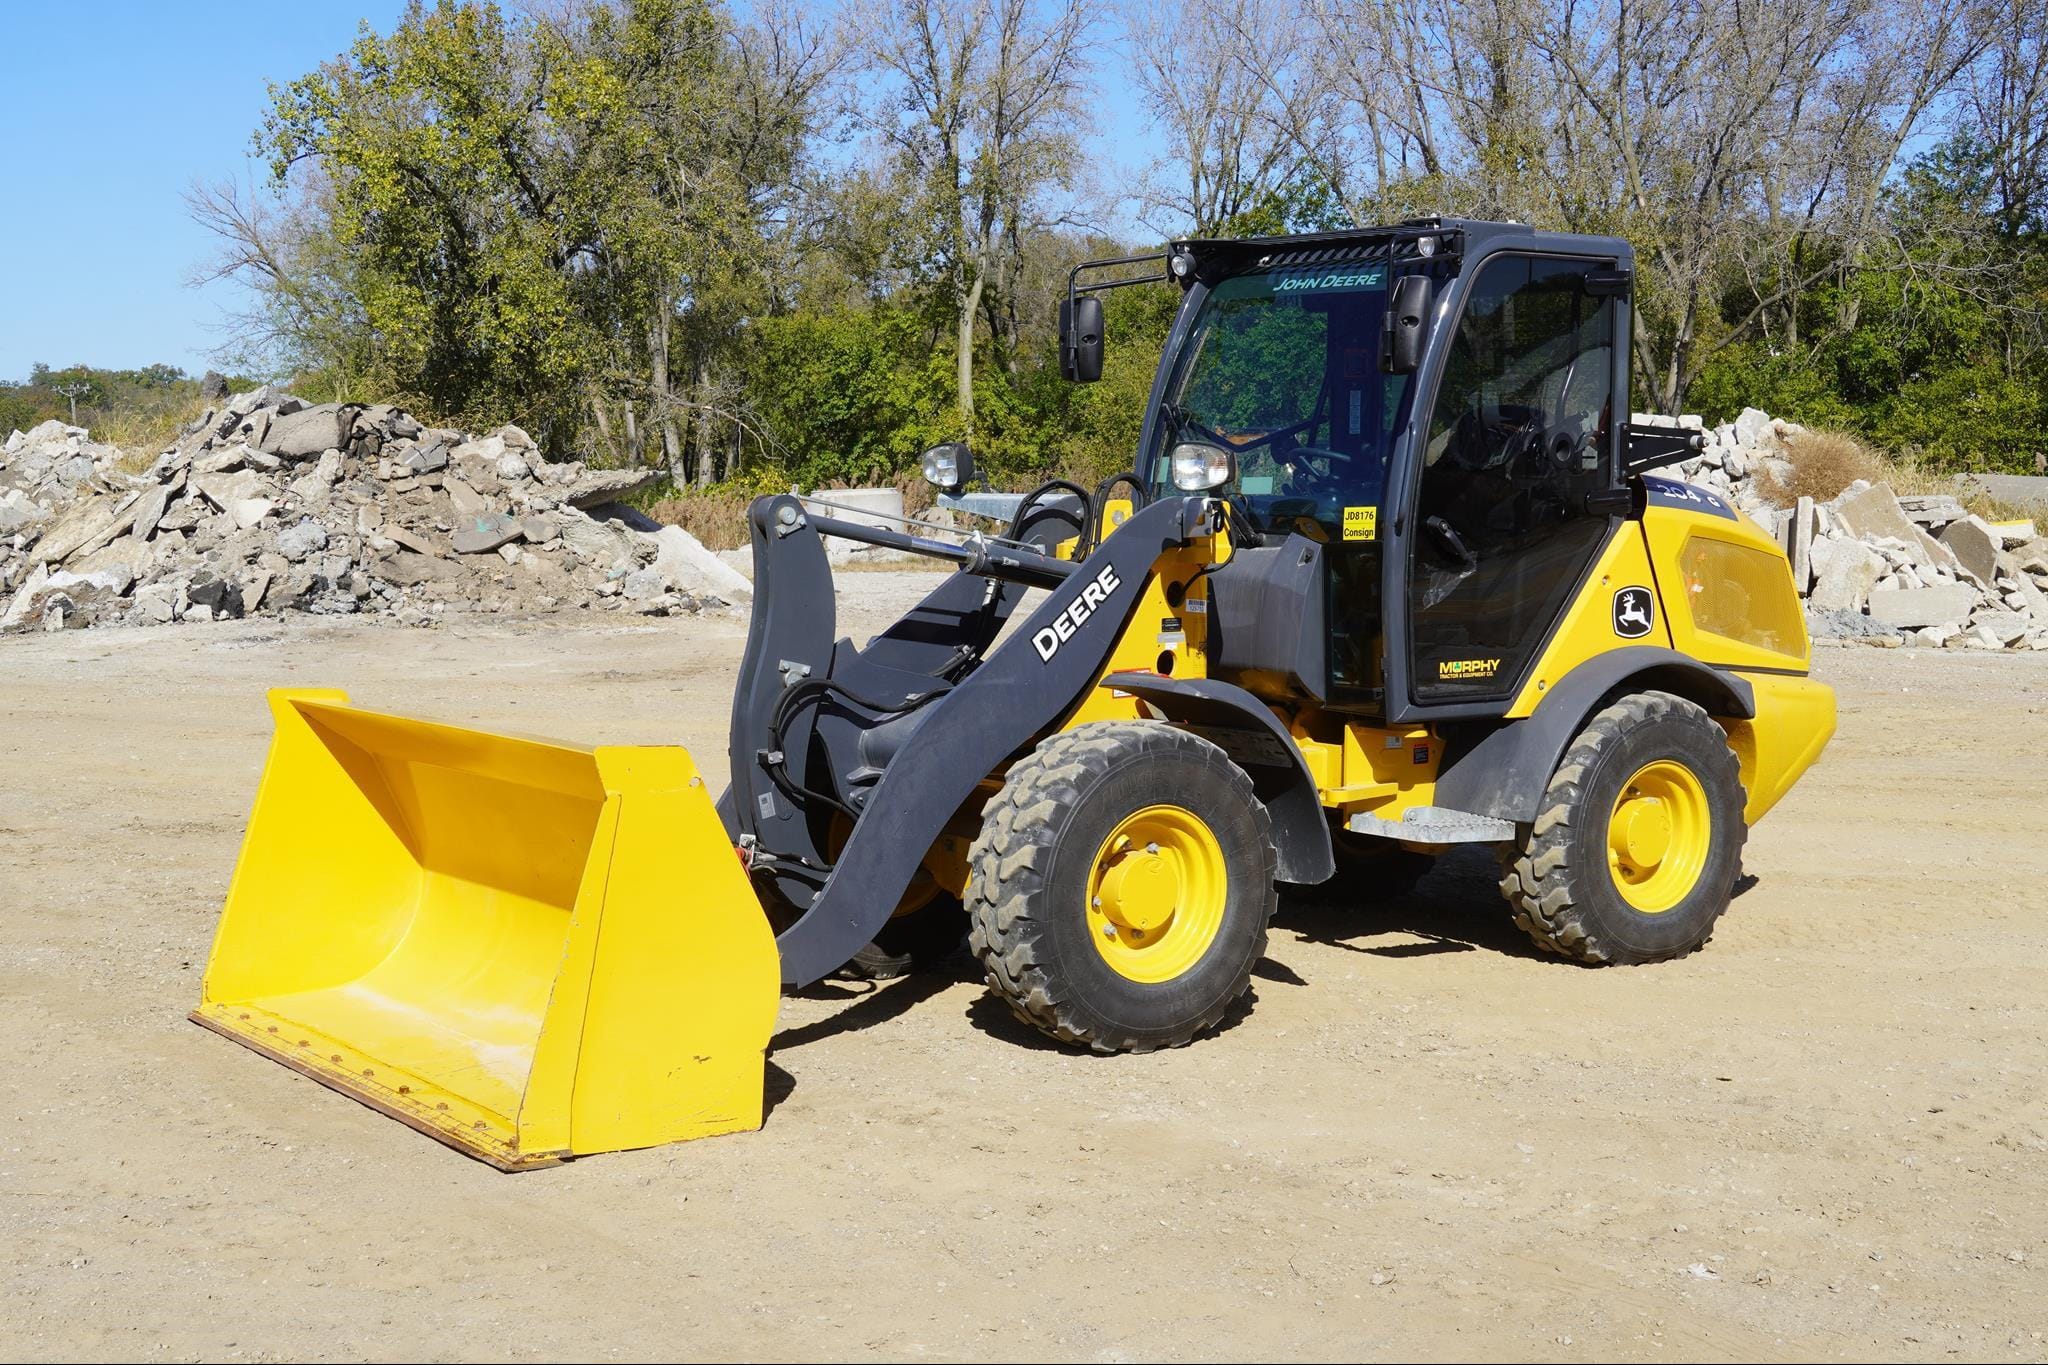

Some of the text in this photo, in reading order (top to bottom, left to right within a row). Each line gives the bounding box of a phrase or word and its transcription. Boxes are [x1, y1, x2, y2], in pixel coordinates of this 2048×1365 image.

[1273, 274, 1381, 291] JOHN DEERE
[1657, 484, 1701, 503] 204
[1345, 511, 1374, 520] JD8176
[1344, 527, 1374, 538] Consign
[1031, 563, 1121, 662] DEERE
[1440, 659, 1500, 673] MURPHY
